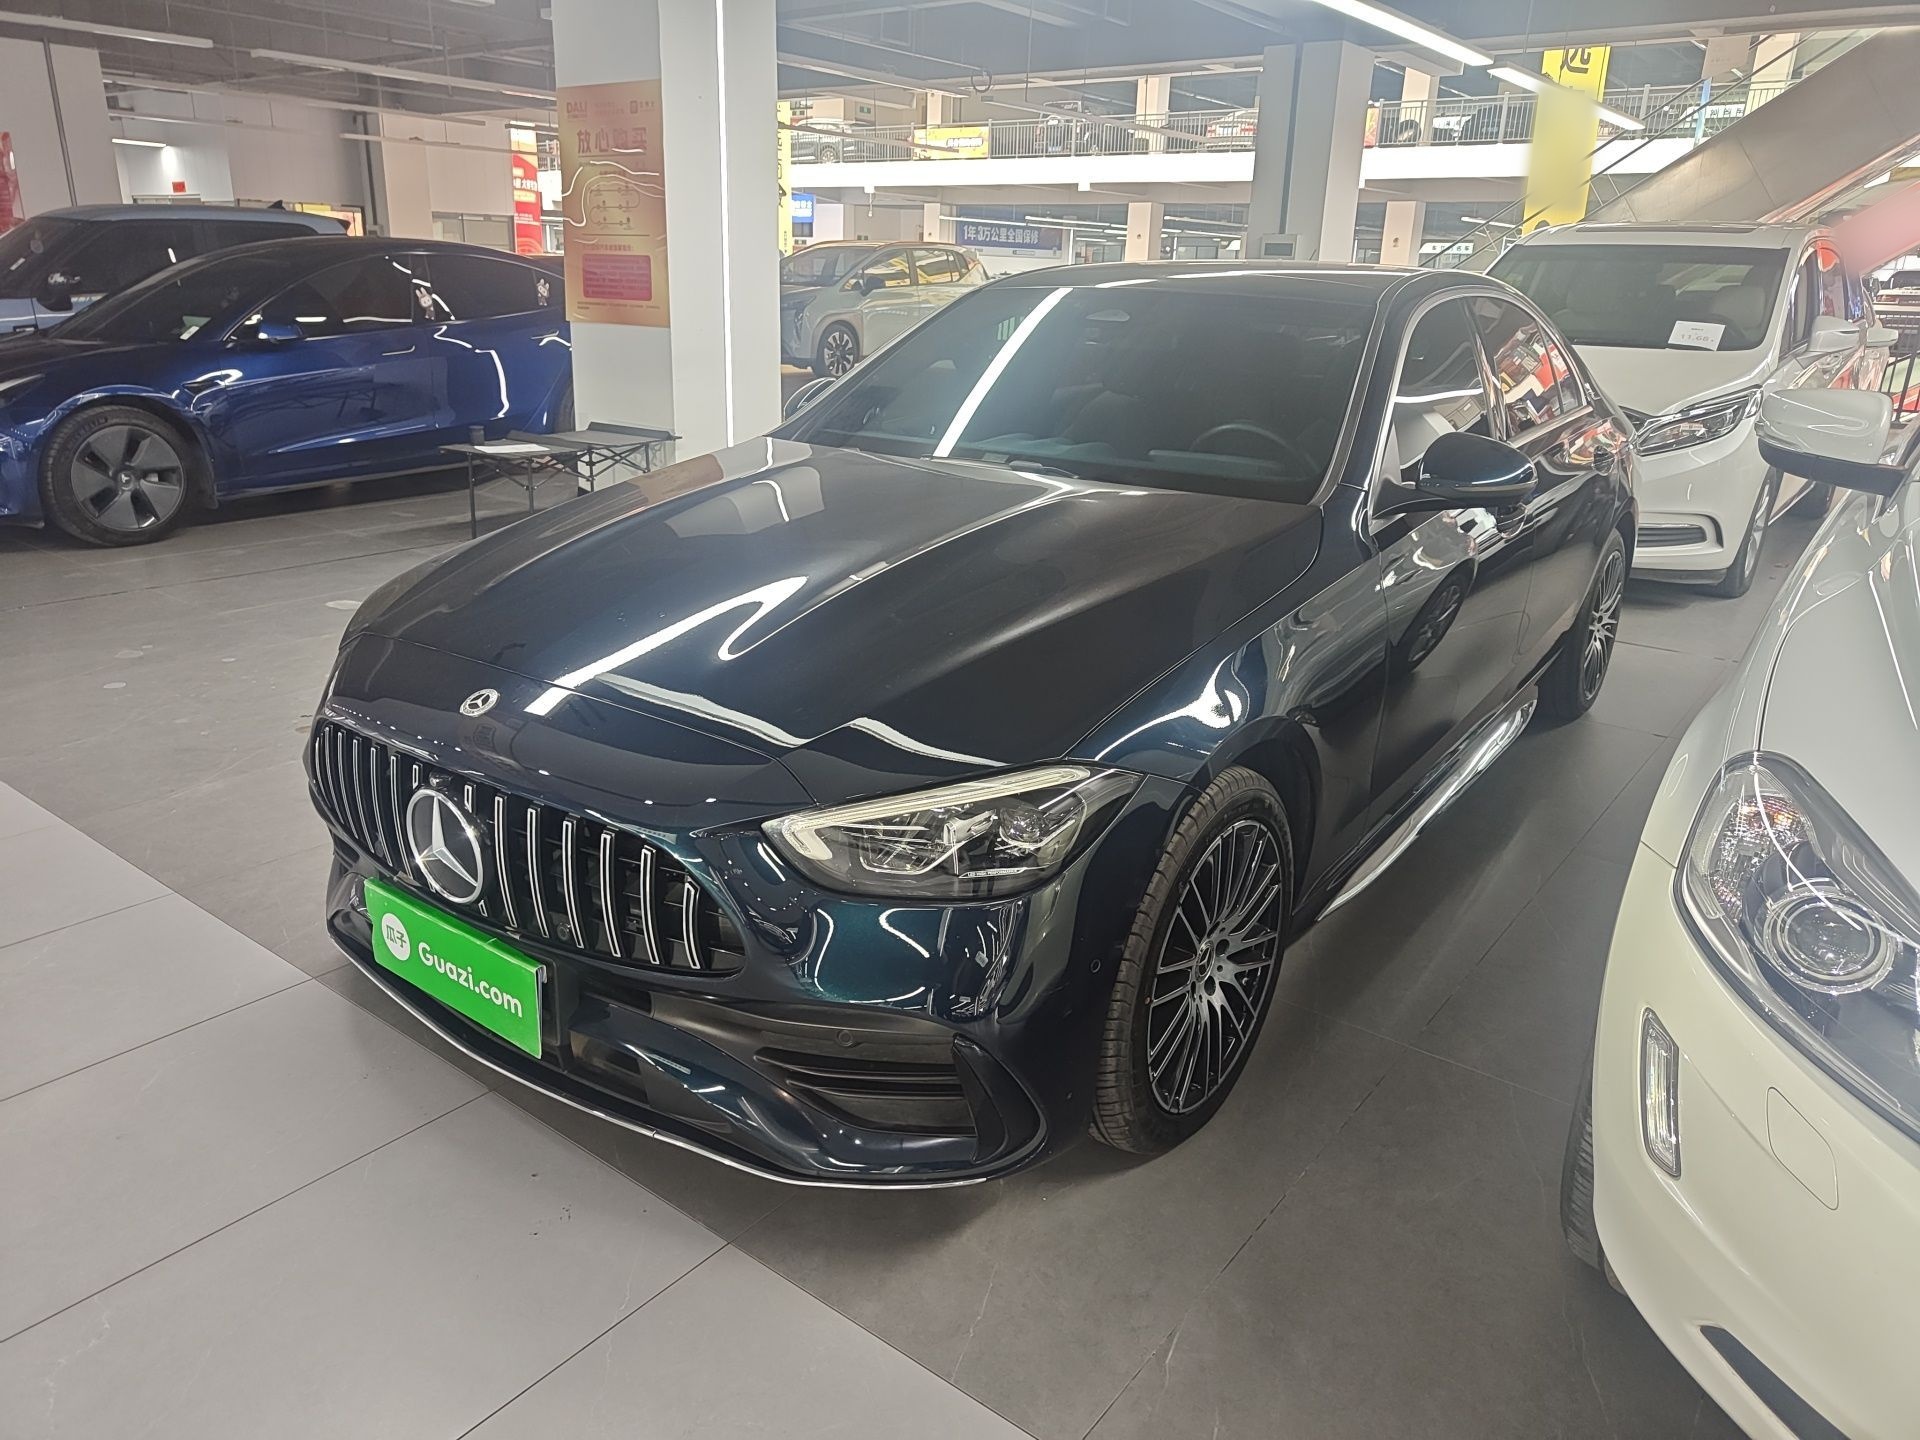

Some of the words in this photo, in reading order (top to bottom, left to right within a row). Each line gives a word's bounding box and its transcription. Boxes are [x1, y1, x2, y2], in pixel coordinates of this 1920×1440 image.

[963, 224, 1040, 244] 1年3万公里全国保修
[385, 924, 408, 949] 瓜子
[418, 941, 523, 1018] Guazi.com
